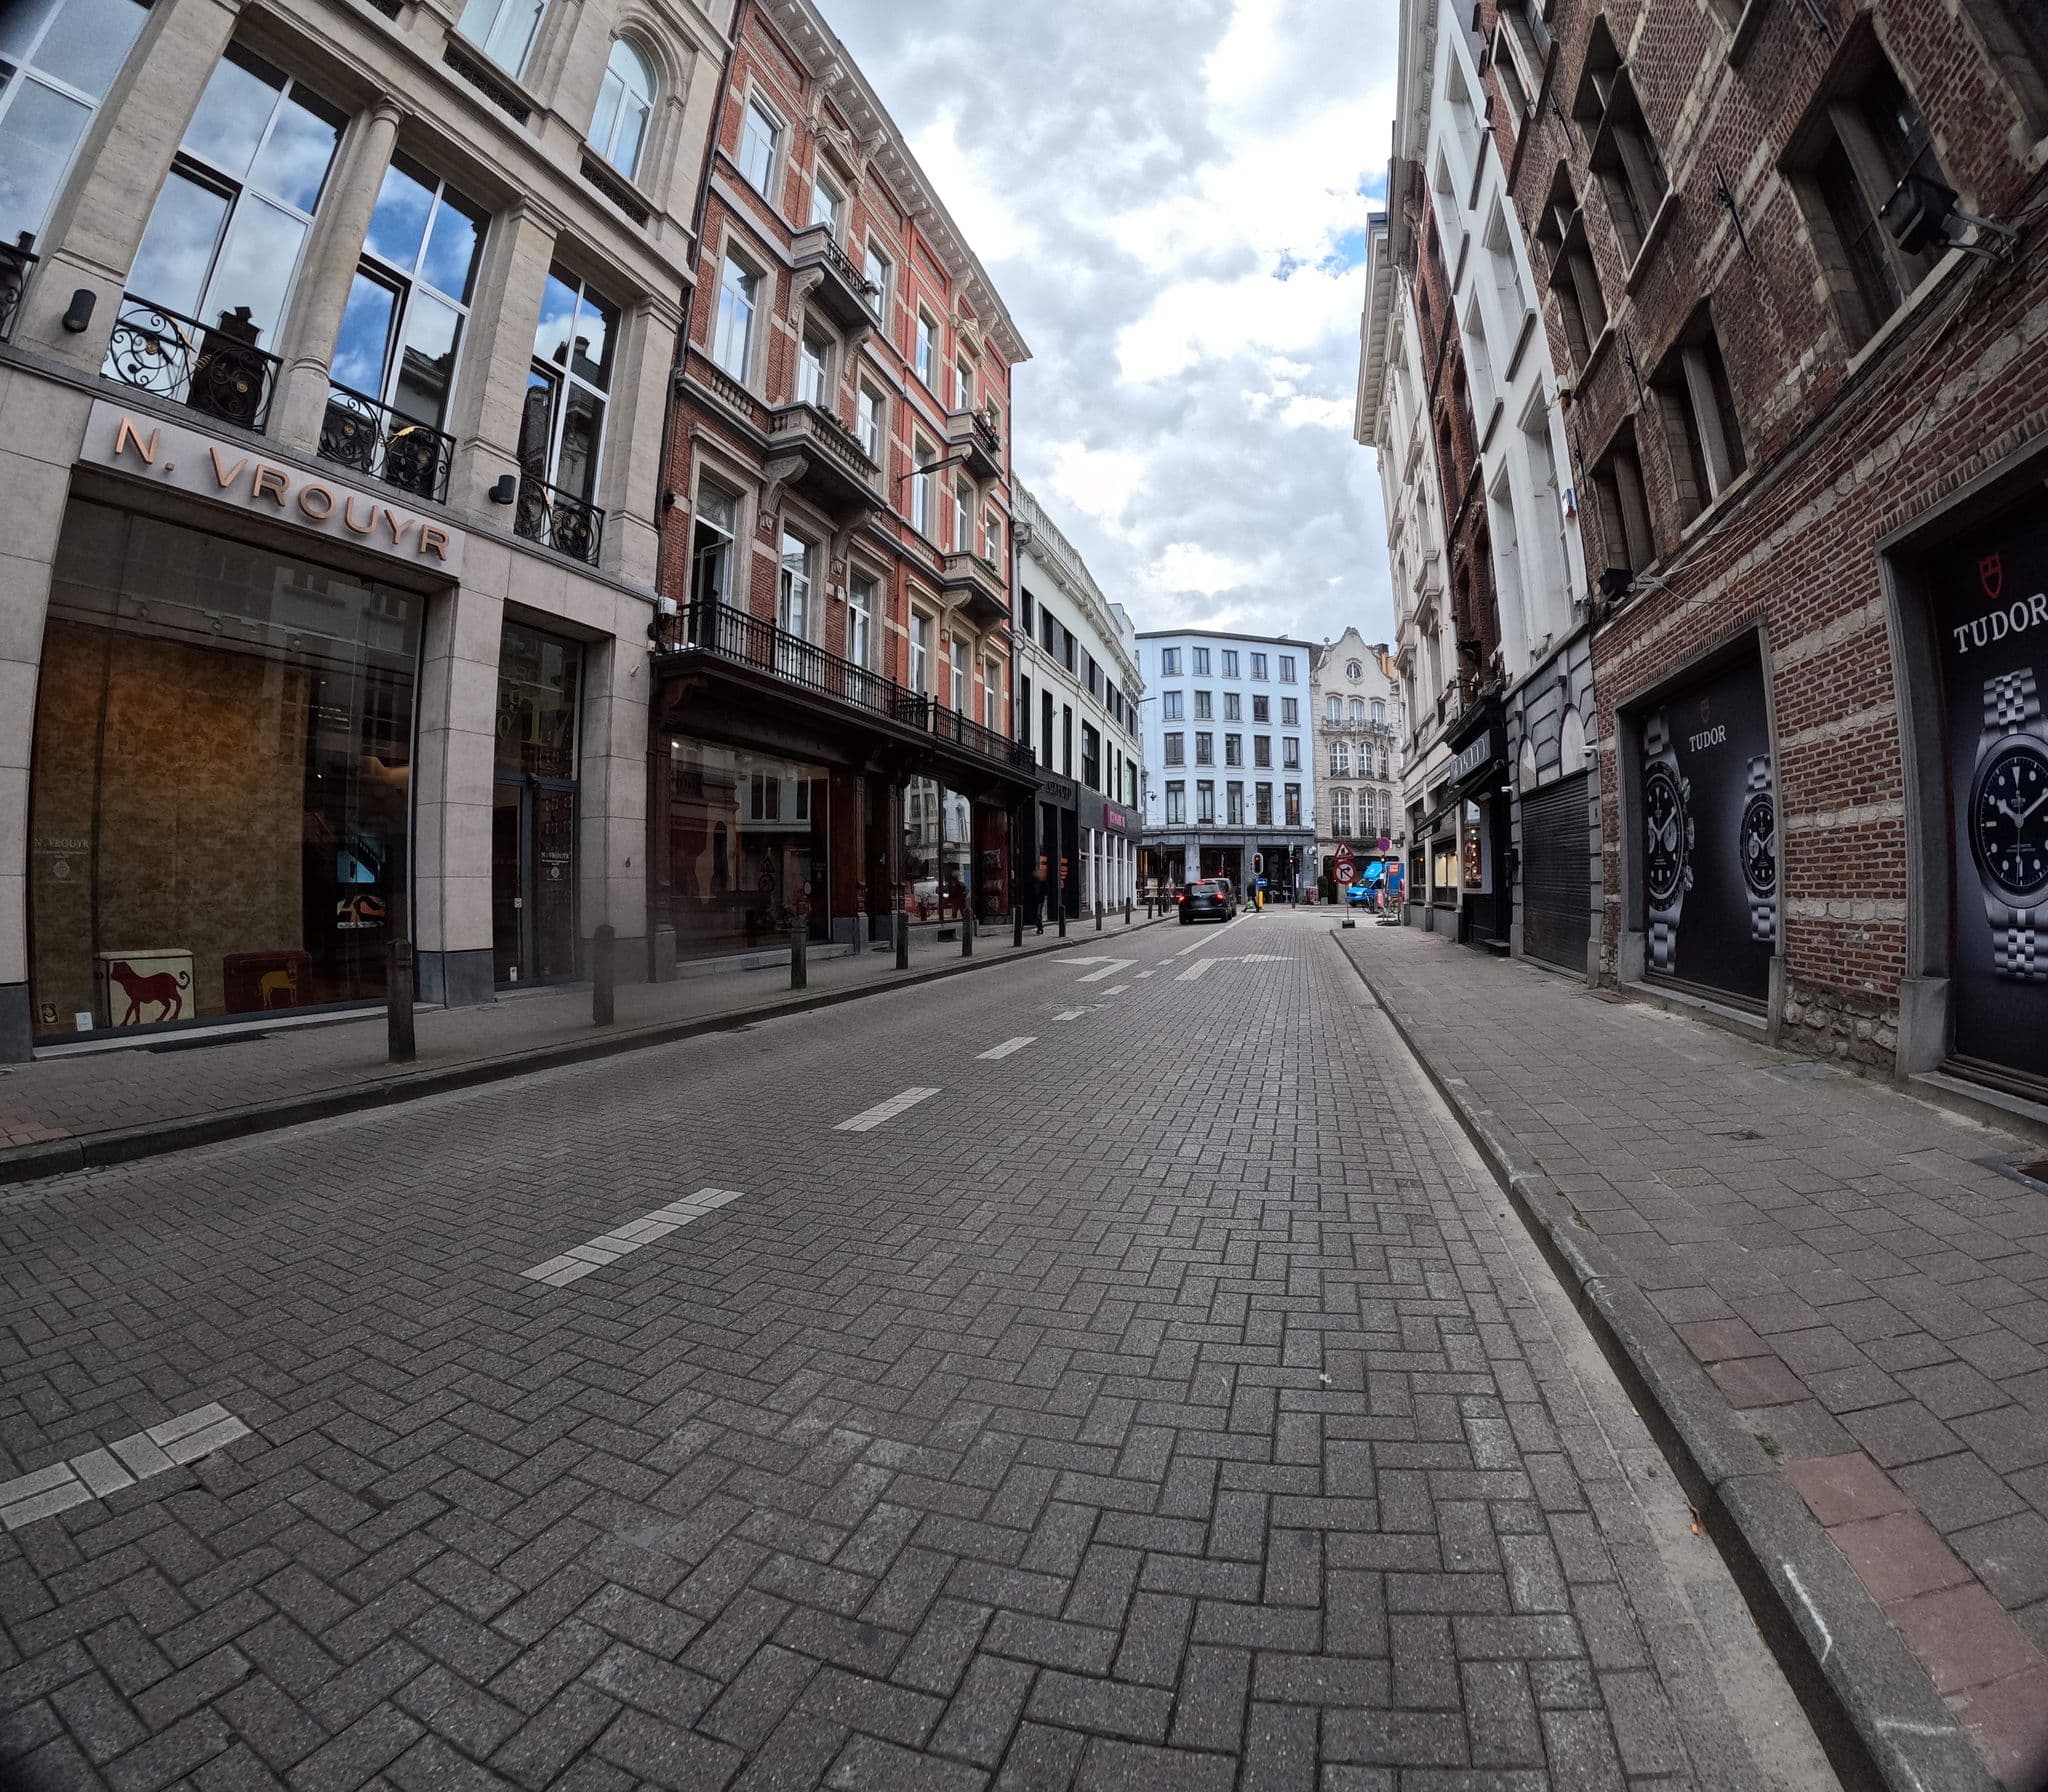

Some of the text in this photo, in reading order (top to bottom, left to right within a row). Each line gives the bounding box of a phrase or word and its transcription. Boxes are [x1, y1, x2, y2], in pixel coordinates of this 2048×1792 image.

[114, 416, 451, 561] N. VROUYR
[1953, 592, 2048, 654] TUDOR
[1688, 724, 1727, 753] TUDOR
[48, 839, 89, 848] VROUYR
[624, 856, 632, 868] 6
